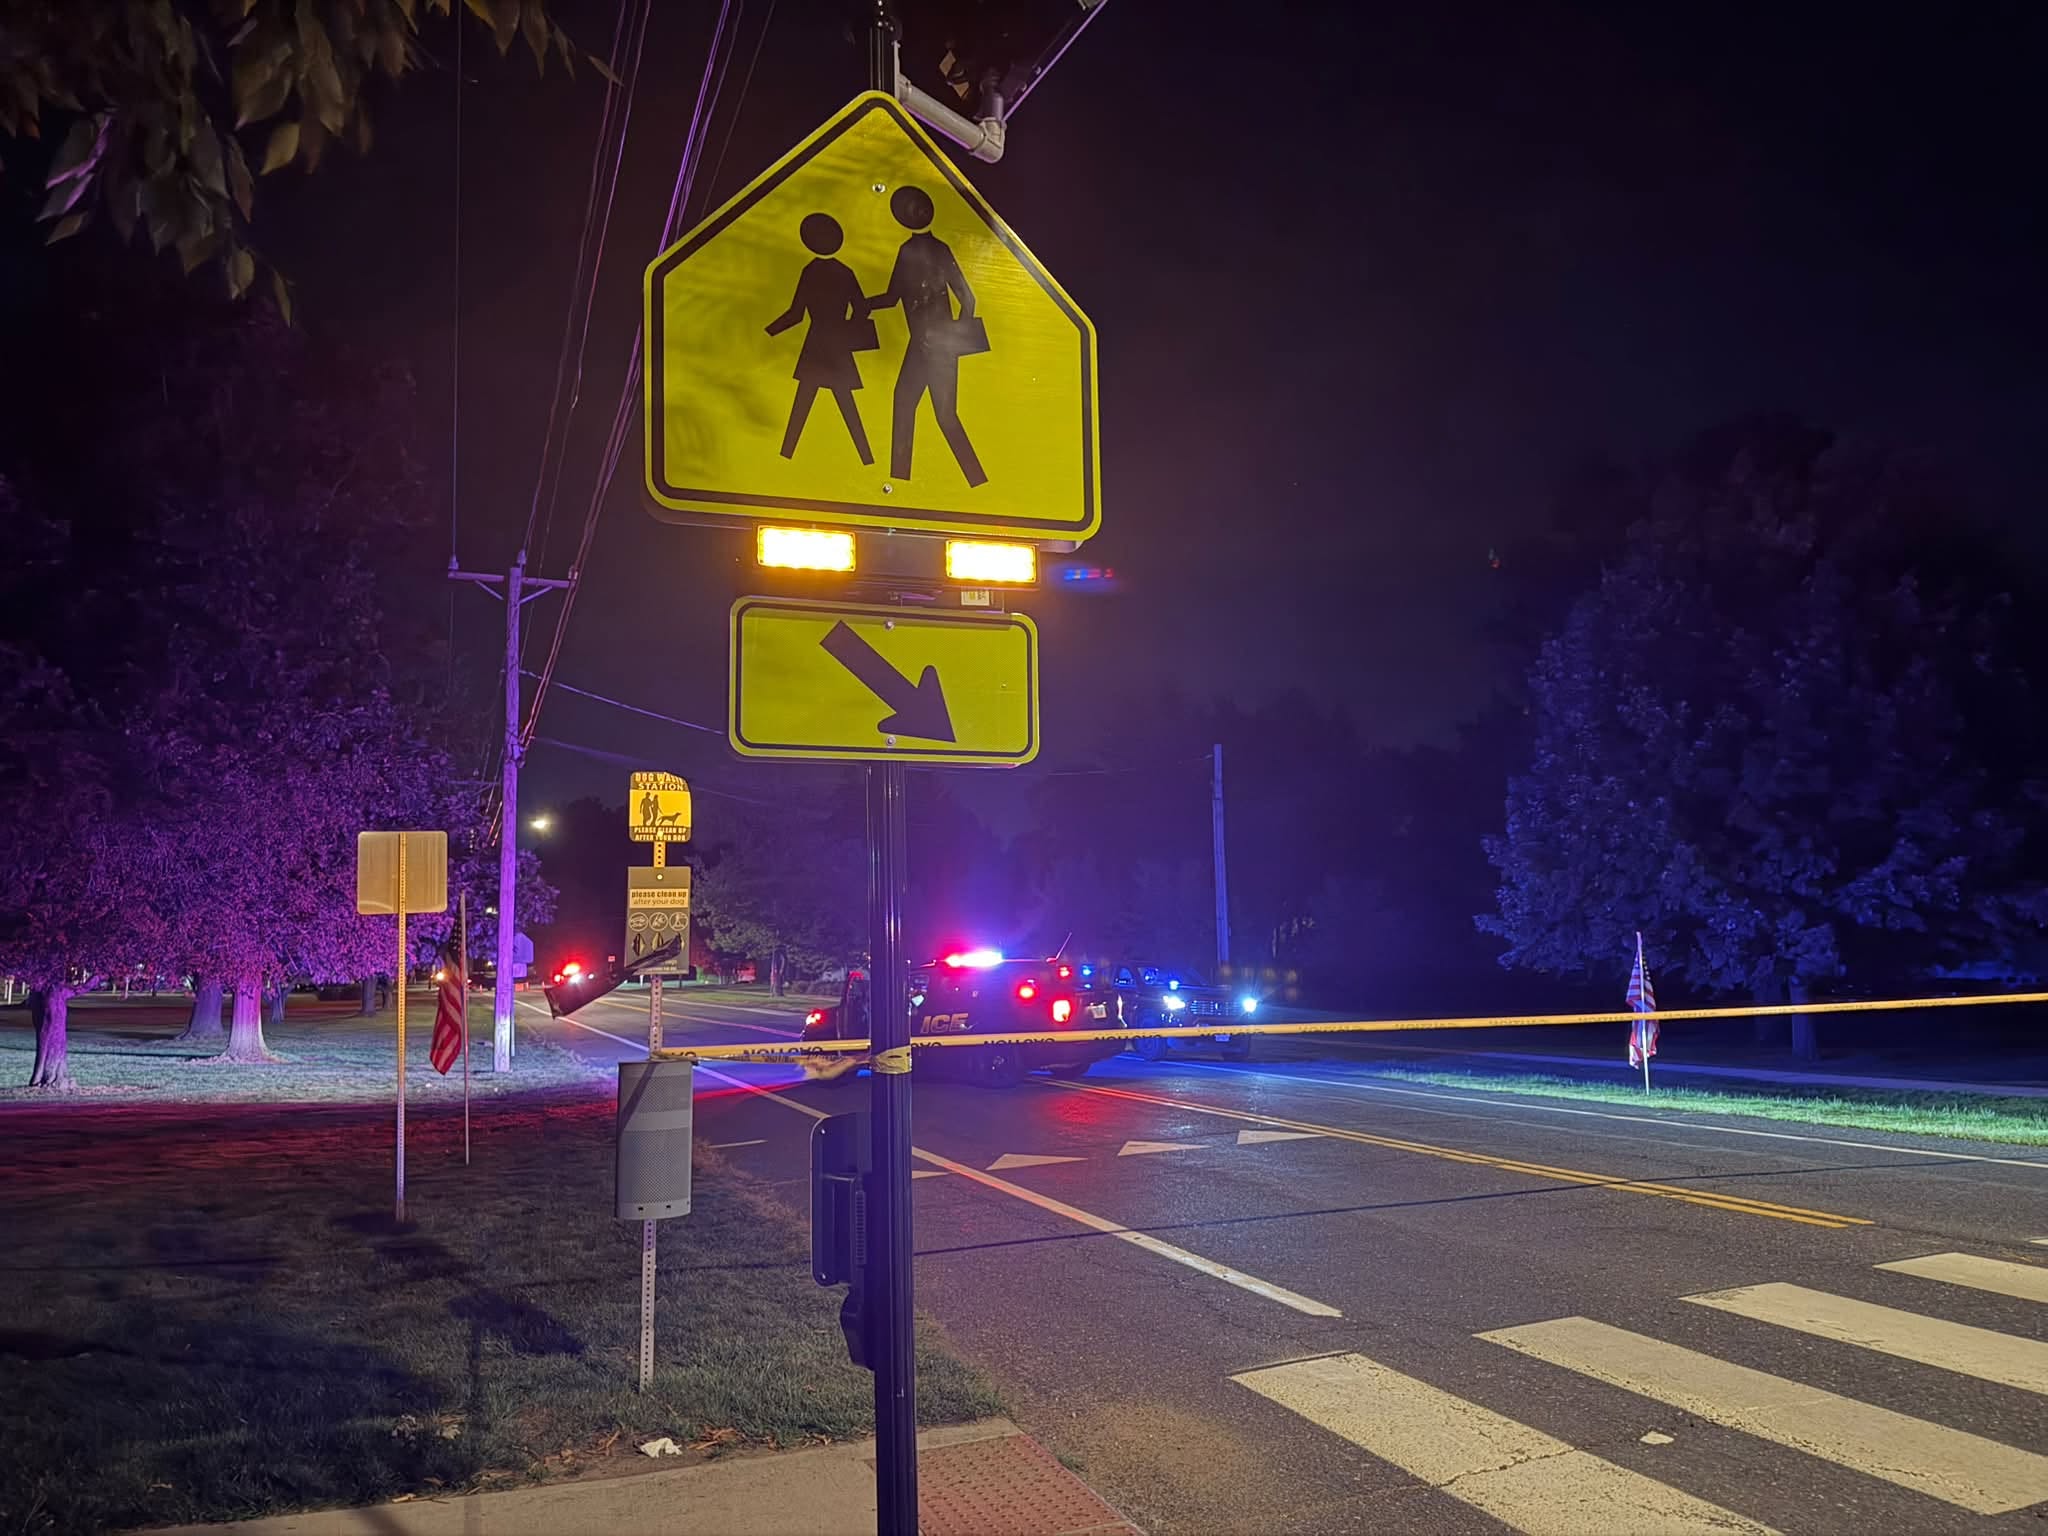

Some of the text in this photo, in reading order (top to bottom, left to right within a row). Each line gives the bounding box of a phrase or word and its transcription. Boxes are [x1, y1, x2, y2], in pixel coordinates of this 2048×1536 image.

[635, 772, 654, 781] DOG
[638, 783, 684, 791] STATION
[631, 890, 656, 898] please
[657, 890, 677, 898] clean
[920, 1013, 969, 1034] ICE
